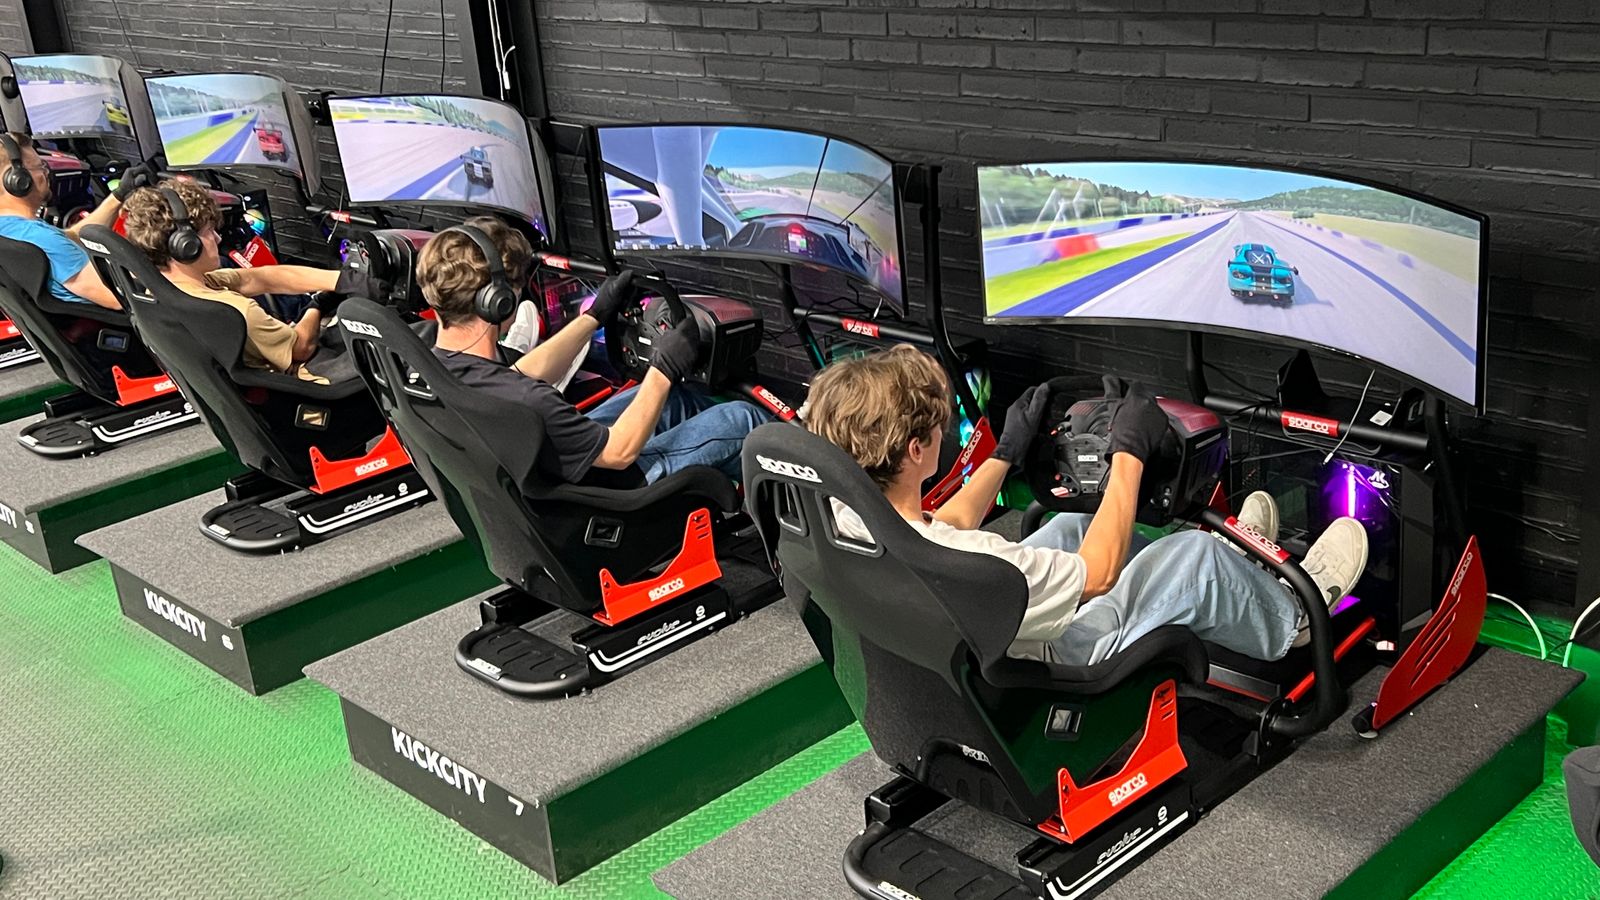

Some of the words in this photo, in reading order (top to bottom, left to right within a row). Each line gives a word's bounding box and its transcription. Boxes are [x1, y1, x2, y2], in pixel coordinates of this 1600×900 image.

[1288, 417, 1329, 434] sparco
[960, 430, 982, 465] sparco
[756, 455, 822, 484] sparco
[1235, 522, 1281, 555] sparco
[648, 578, 685, 602] sparco
[1451, 552, 1473, 597] sparco
[144, 588, 206, 642] KICKCITY
[391, 726, 486, 802] KICKCITY
[507, 795, 524, 816] 7
[1108, 772, 1148, 807] sparco
